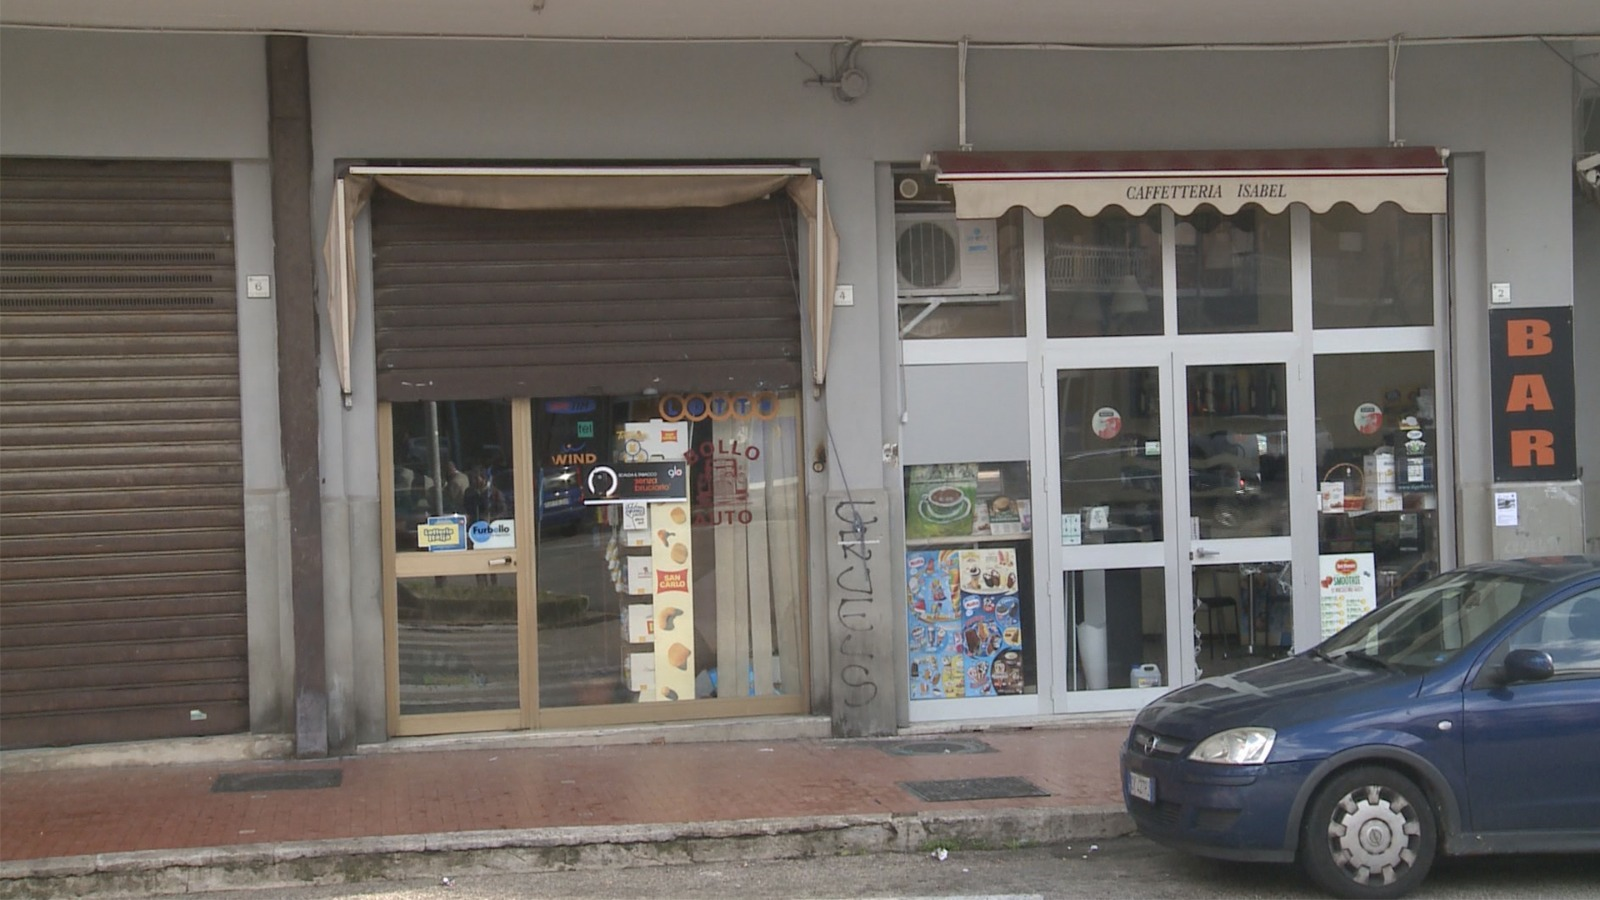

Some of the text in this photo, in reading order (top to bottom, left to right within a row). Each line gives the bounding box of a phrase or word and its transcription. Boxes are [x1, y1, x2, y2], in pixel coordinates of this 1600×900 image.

[1126, 183, 1287, 200] CAFFETTERIA ISABEL
[1506, 319, 1555, 467] BAR
[578, 423, 592, 434] tel
[552, 453, 597, 465] WIND
[684, 439, 761, 465] BOLLO
[668, 465, 683, 478] glo
[695, 509, 753, 526] AUTO
[659, 580, 686, 589] CARLO
